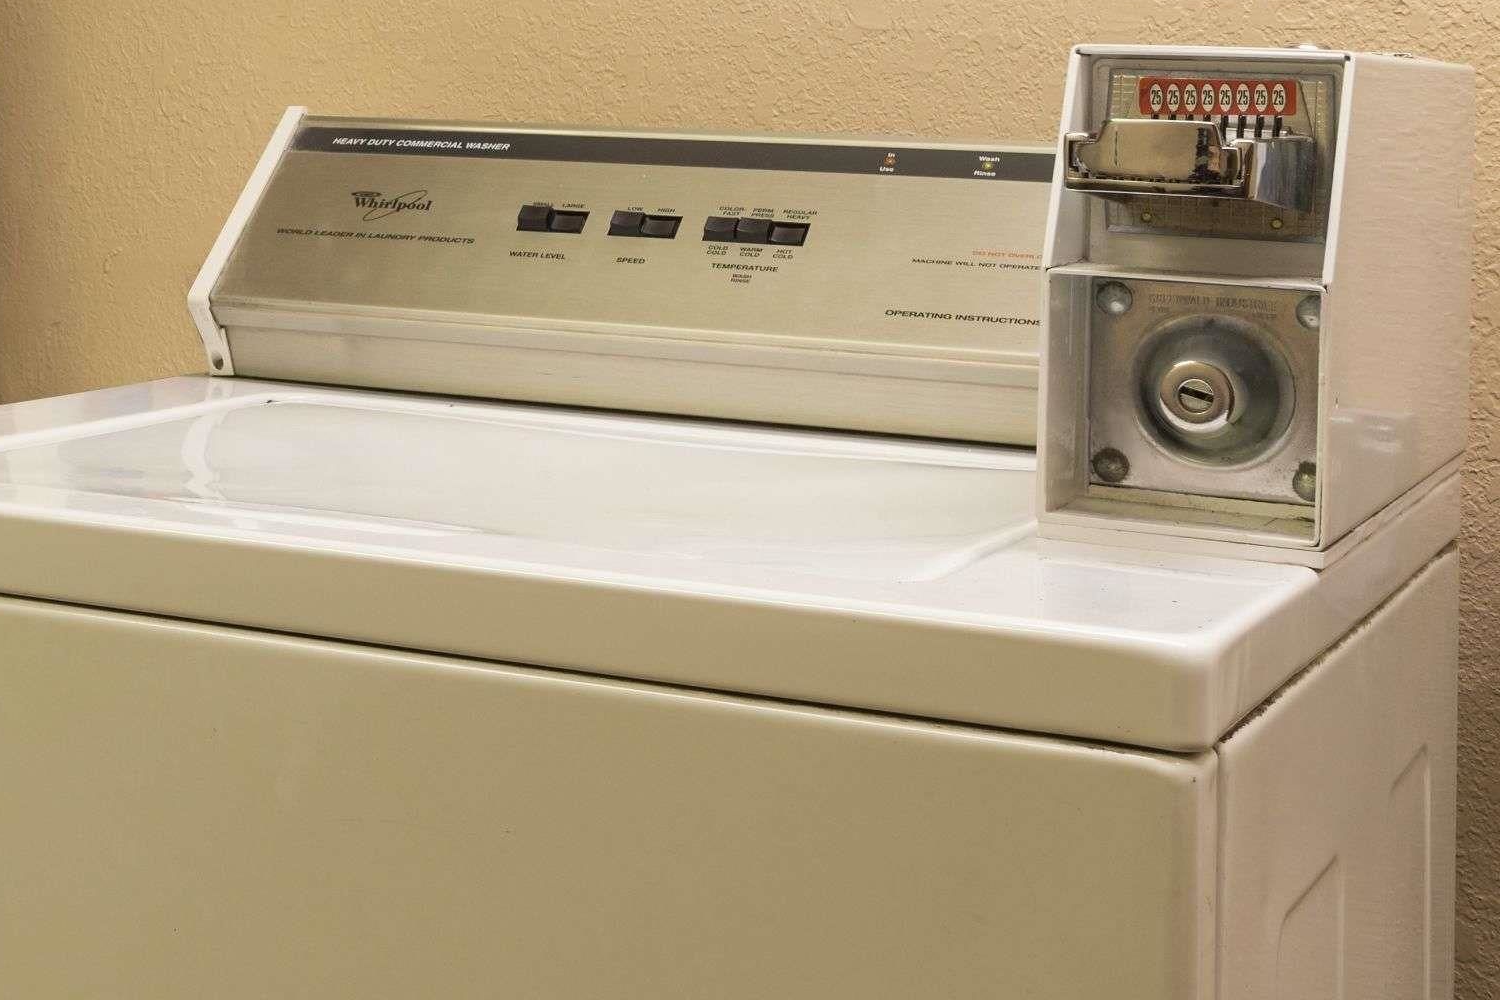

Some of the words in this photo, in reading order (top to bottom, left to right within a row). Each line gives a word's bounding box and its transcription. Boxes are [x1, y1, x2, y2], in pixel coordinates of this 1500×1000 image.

[1151, 89, 1161, 106] 25
[1168, 89, 1178, 106] 25
[1185, 89, 1195, 106] 25
[1203, 89, 1213, 106] 25
[1220, 89, 1230, 106] 25
[1238, 89, 1248, 106] 25
[1255, 89, 1266, 106] 25
[1273, 89, 1284, 106] 25
[332, 137, 367, 146] HEAVY
[367, 138, 397, 147] DUTY
[396, 139, 463, 149] COMMERCIAL
[465, 142, 511, 152] WASHER
[355, 197, 433, 212] Whirlpool
[277, 228, 313, 236] WORLD
[314, 230, 355, 238] LEADER
[368, 233, 416, 241] LAUNDRY
[418, 235, 475, 244] PRODUCTS
[540, 252, 566, 260] LEVEL
[711, 263, 779, 272] TEMPERATURE
[884, 309, 953, 320] OPERATING
